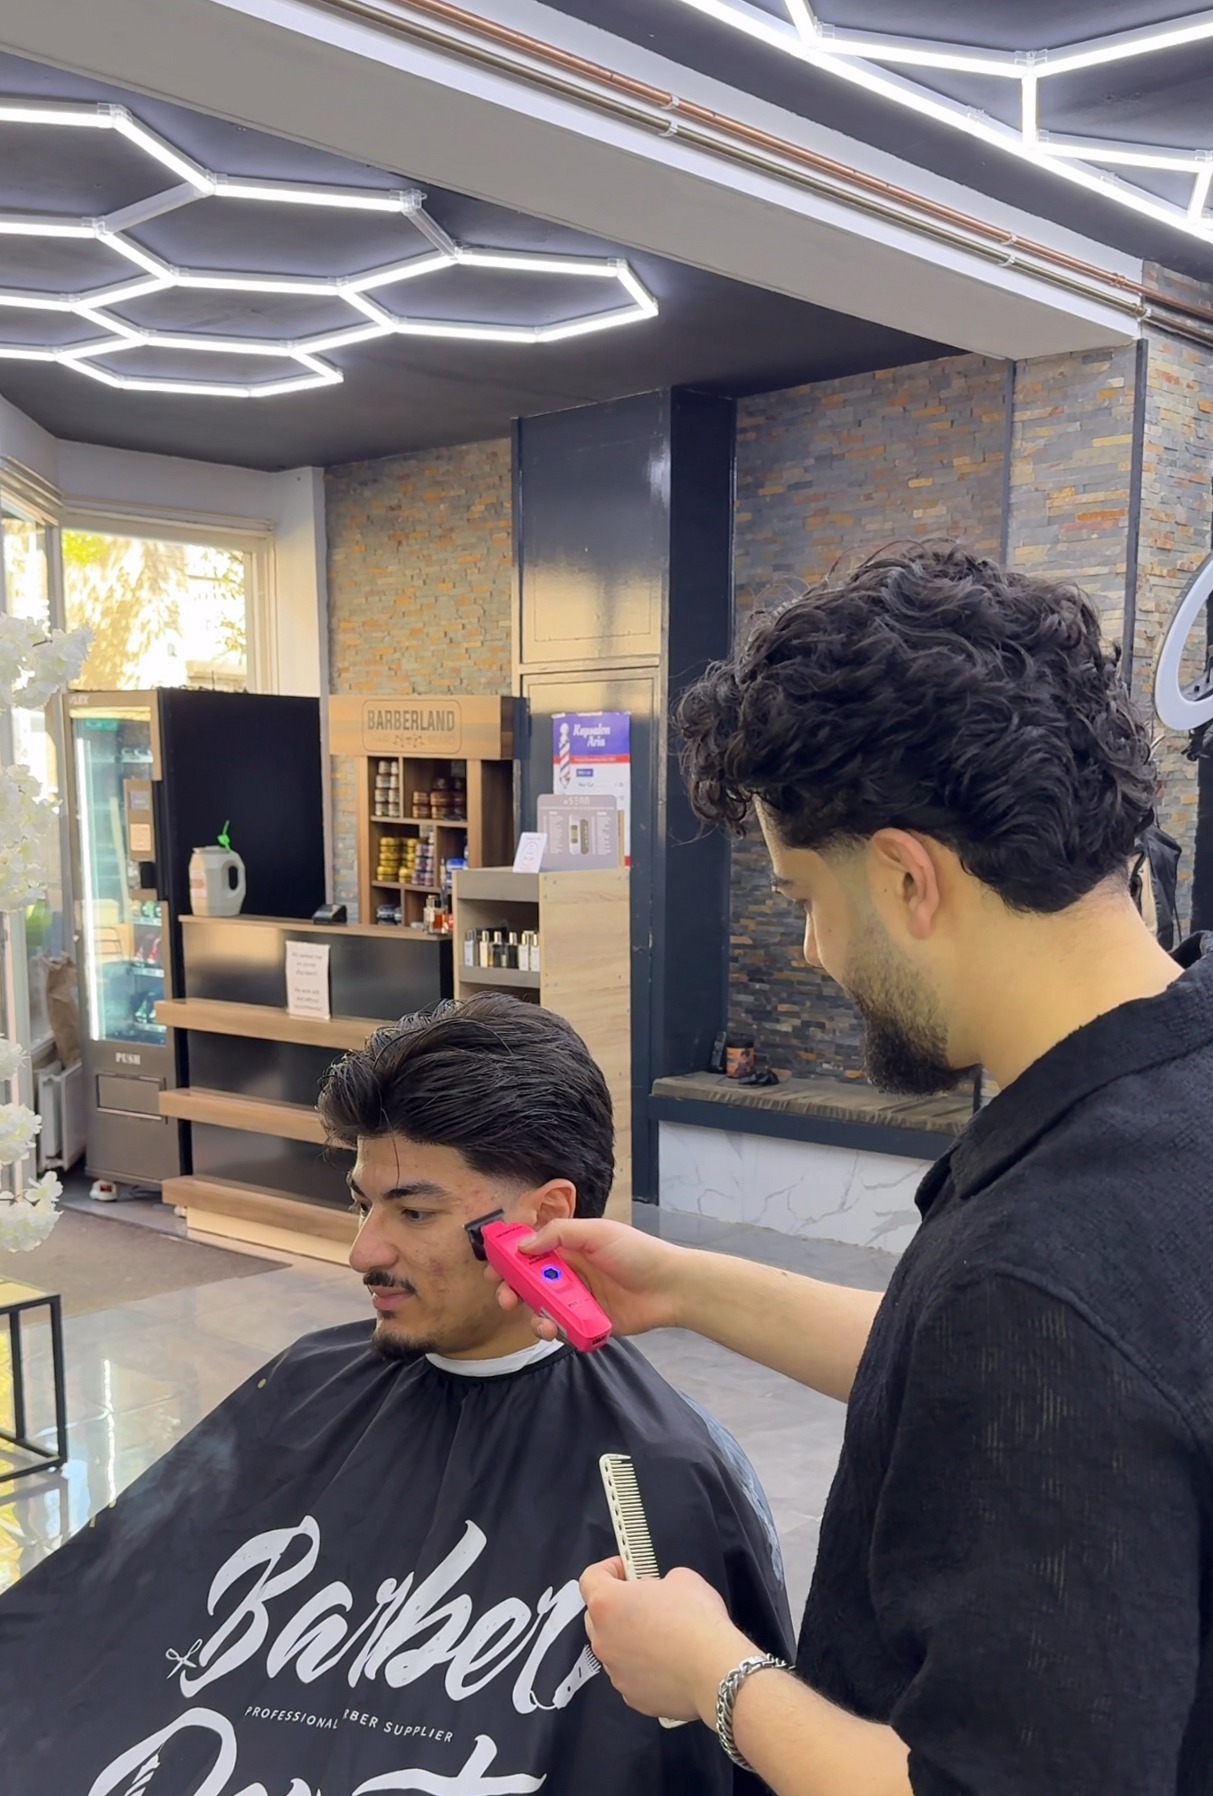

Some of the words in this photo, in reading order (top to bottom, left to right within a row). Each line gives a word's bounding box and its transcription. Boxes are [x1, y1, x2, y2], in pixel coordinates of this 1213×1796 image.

[367, 709, 456, 732] BARBERLAND
[115, 1052, 142, 1066] PUSH
[180, 1515, 588, 1714] Barber
[244, 1706, 339, 1730] PROFESSIONAL
[383, 1721, 453, 1743] SUPPLIER
